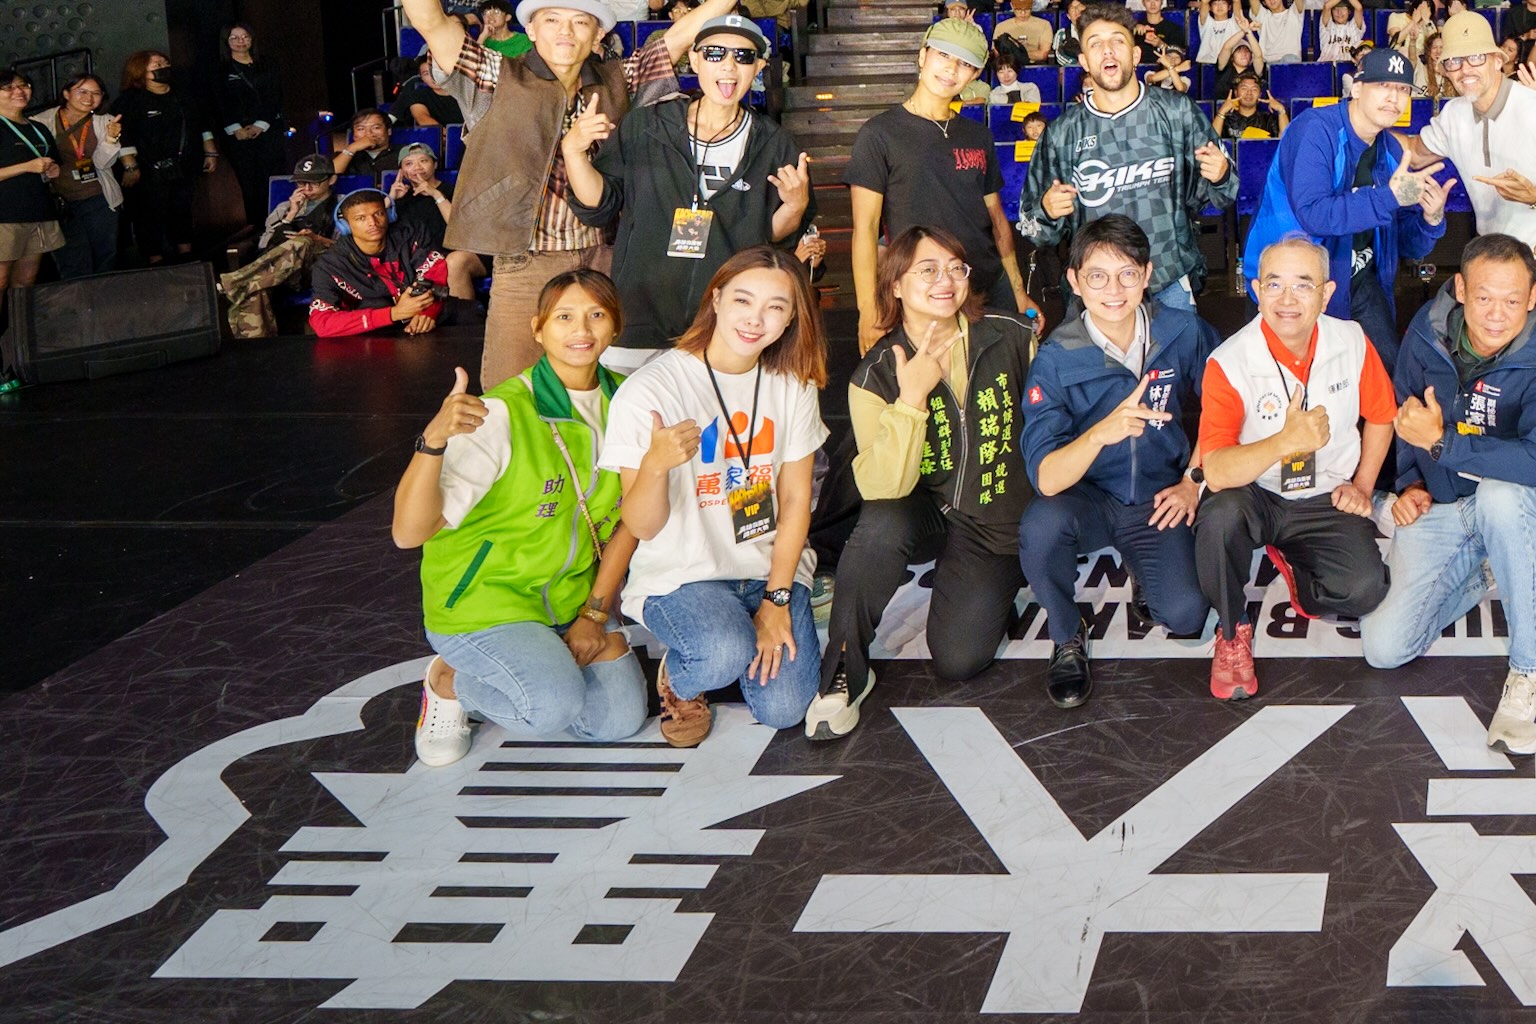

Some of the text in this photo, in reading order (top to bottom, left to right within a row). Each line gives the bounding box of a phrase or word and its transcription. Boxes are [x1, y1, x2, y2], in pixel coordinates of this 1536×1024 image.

[726, 15, 743, 27] C
[302, 160, 313, 172] S
[1079, 157, 1175, 193] KIKS
[1116, 180, 1151, 193] TRIUMPH
[976, 387, 1000, 465] 賴瑞隆
[995, 372, 1014, 456] 市長候選人
[1469, 393, 1487, 435] 張家
[1291, 461, 1305, 472] VIP
[534, 473, 566, 519] 助理
[979, 471, 994, 506] 團隊
[744, 503, 761, 518] VIP
